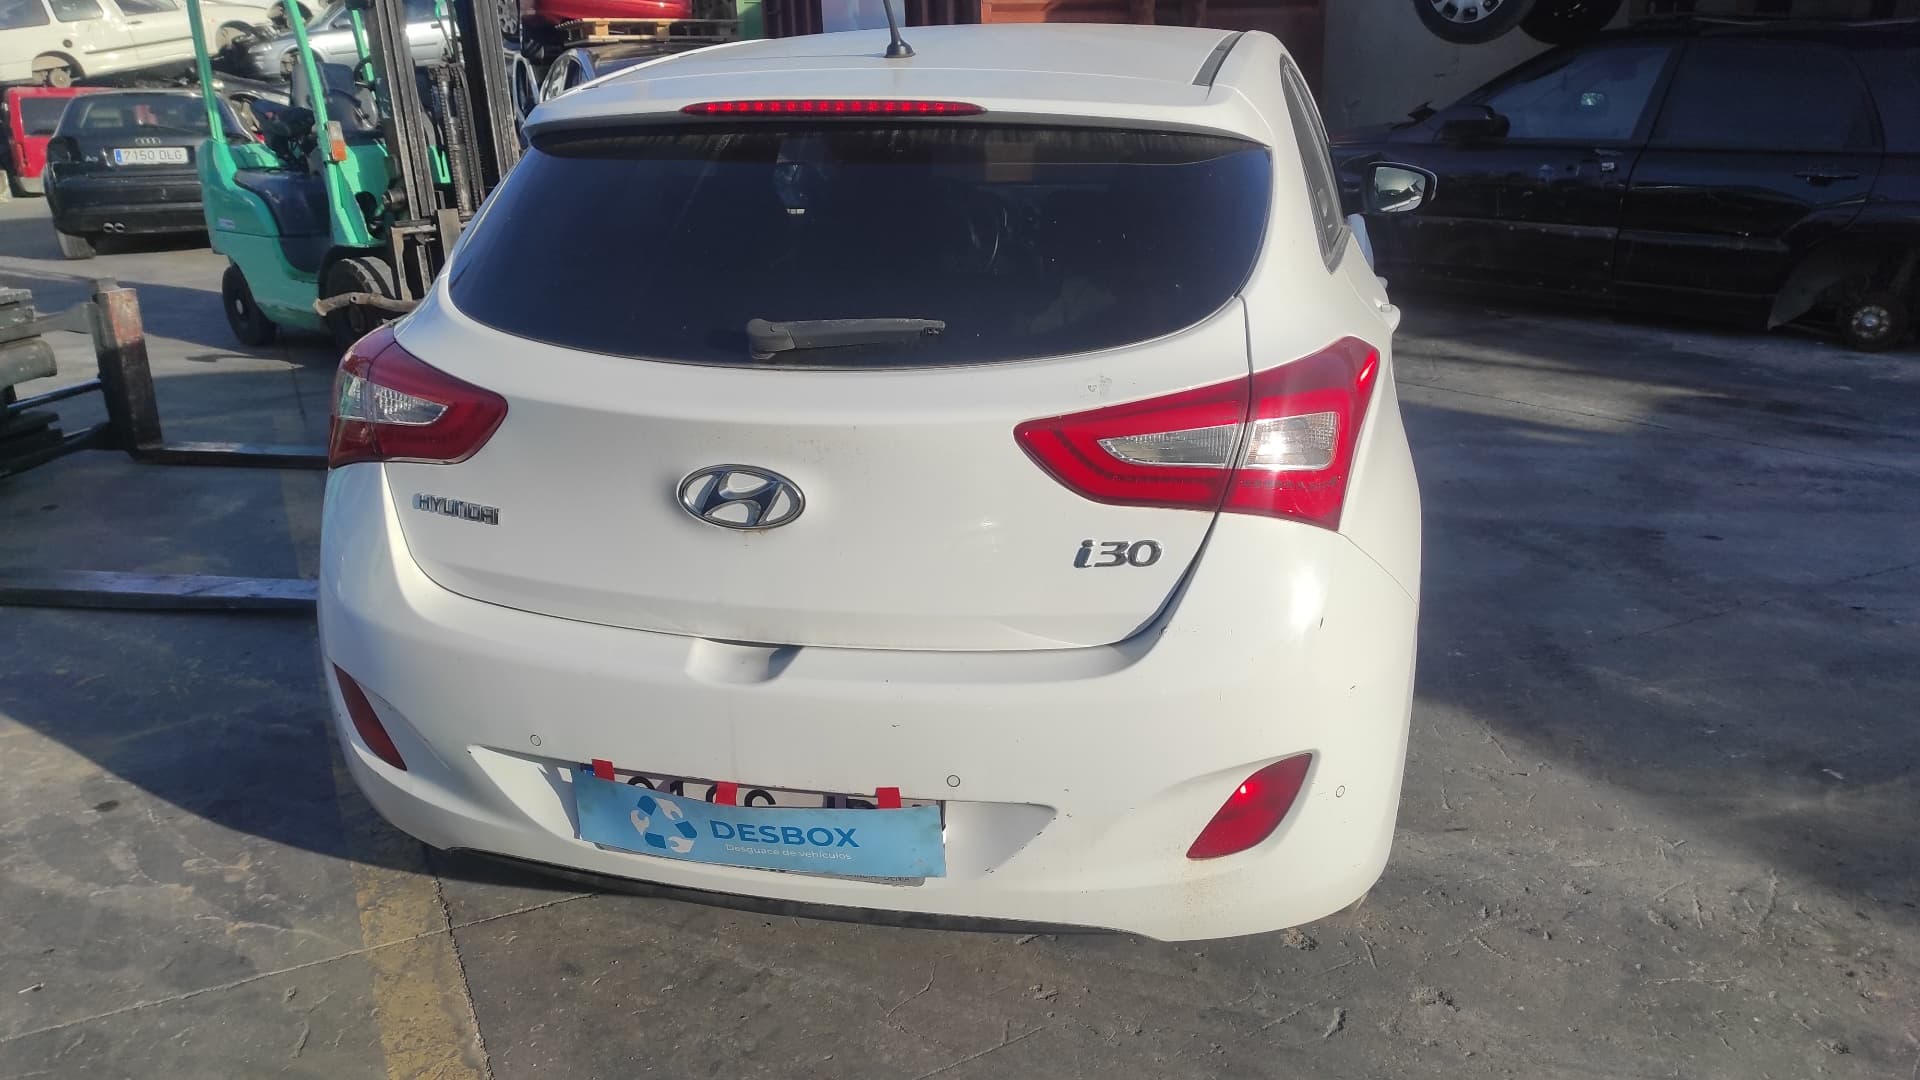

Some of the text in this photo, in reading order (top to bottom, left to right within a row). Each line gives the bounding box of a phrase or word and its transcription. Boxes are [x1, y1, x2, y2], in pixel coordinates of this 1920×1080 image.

[124, 150, 182, 161] 7150 DLG
[411, 492, 500, 526] HYUNDAI
[1073, 539, 1162, 568] i30
[709, 819, 860, 848] DESBOX
[726, 844, 780, 856] Desguace
[782, 849, 797, 857] de
